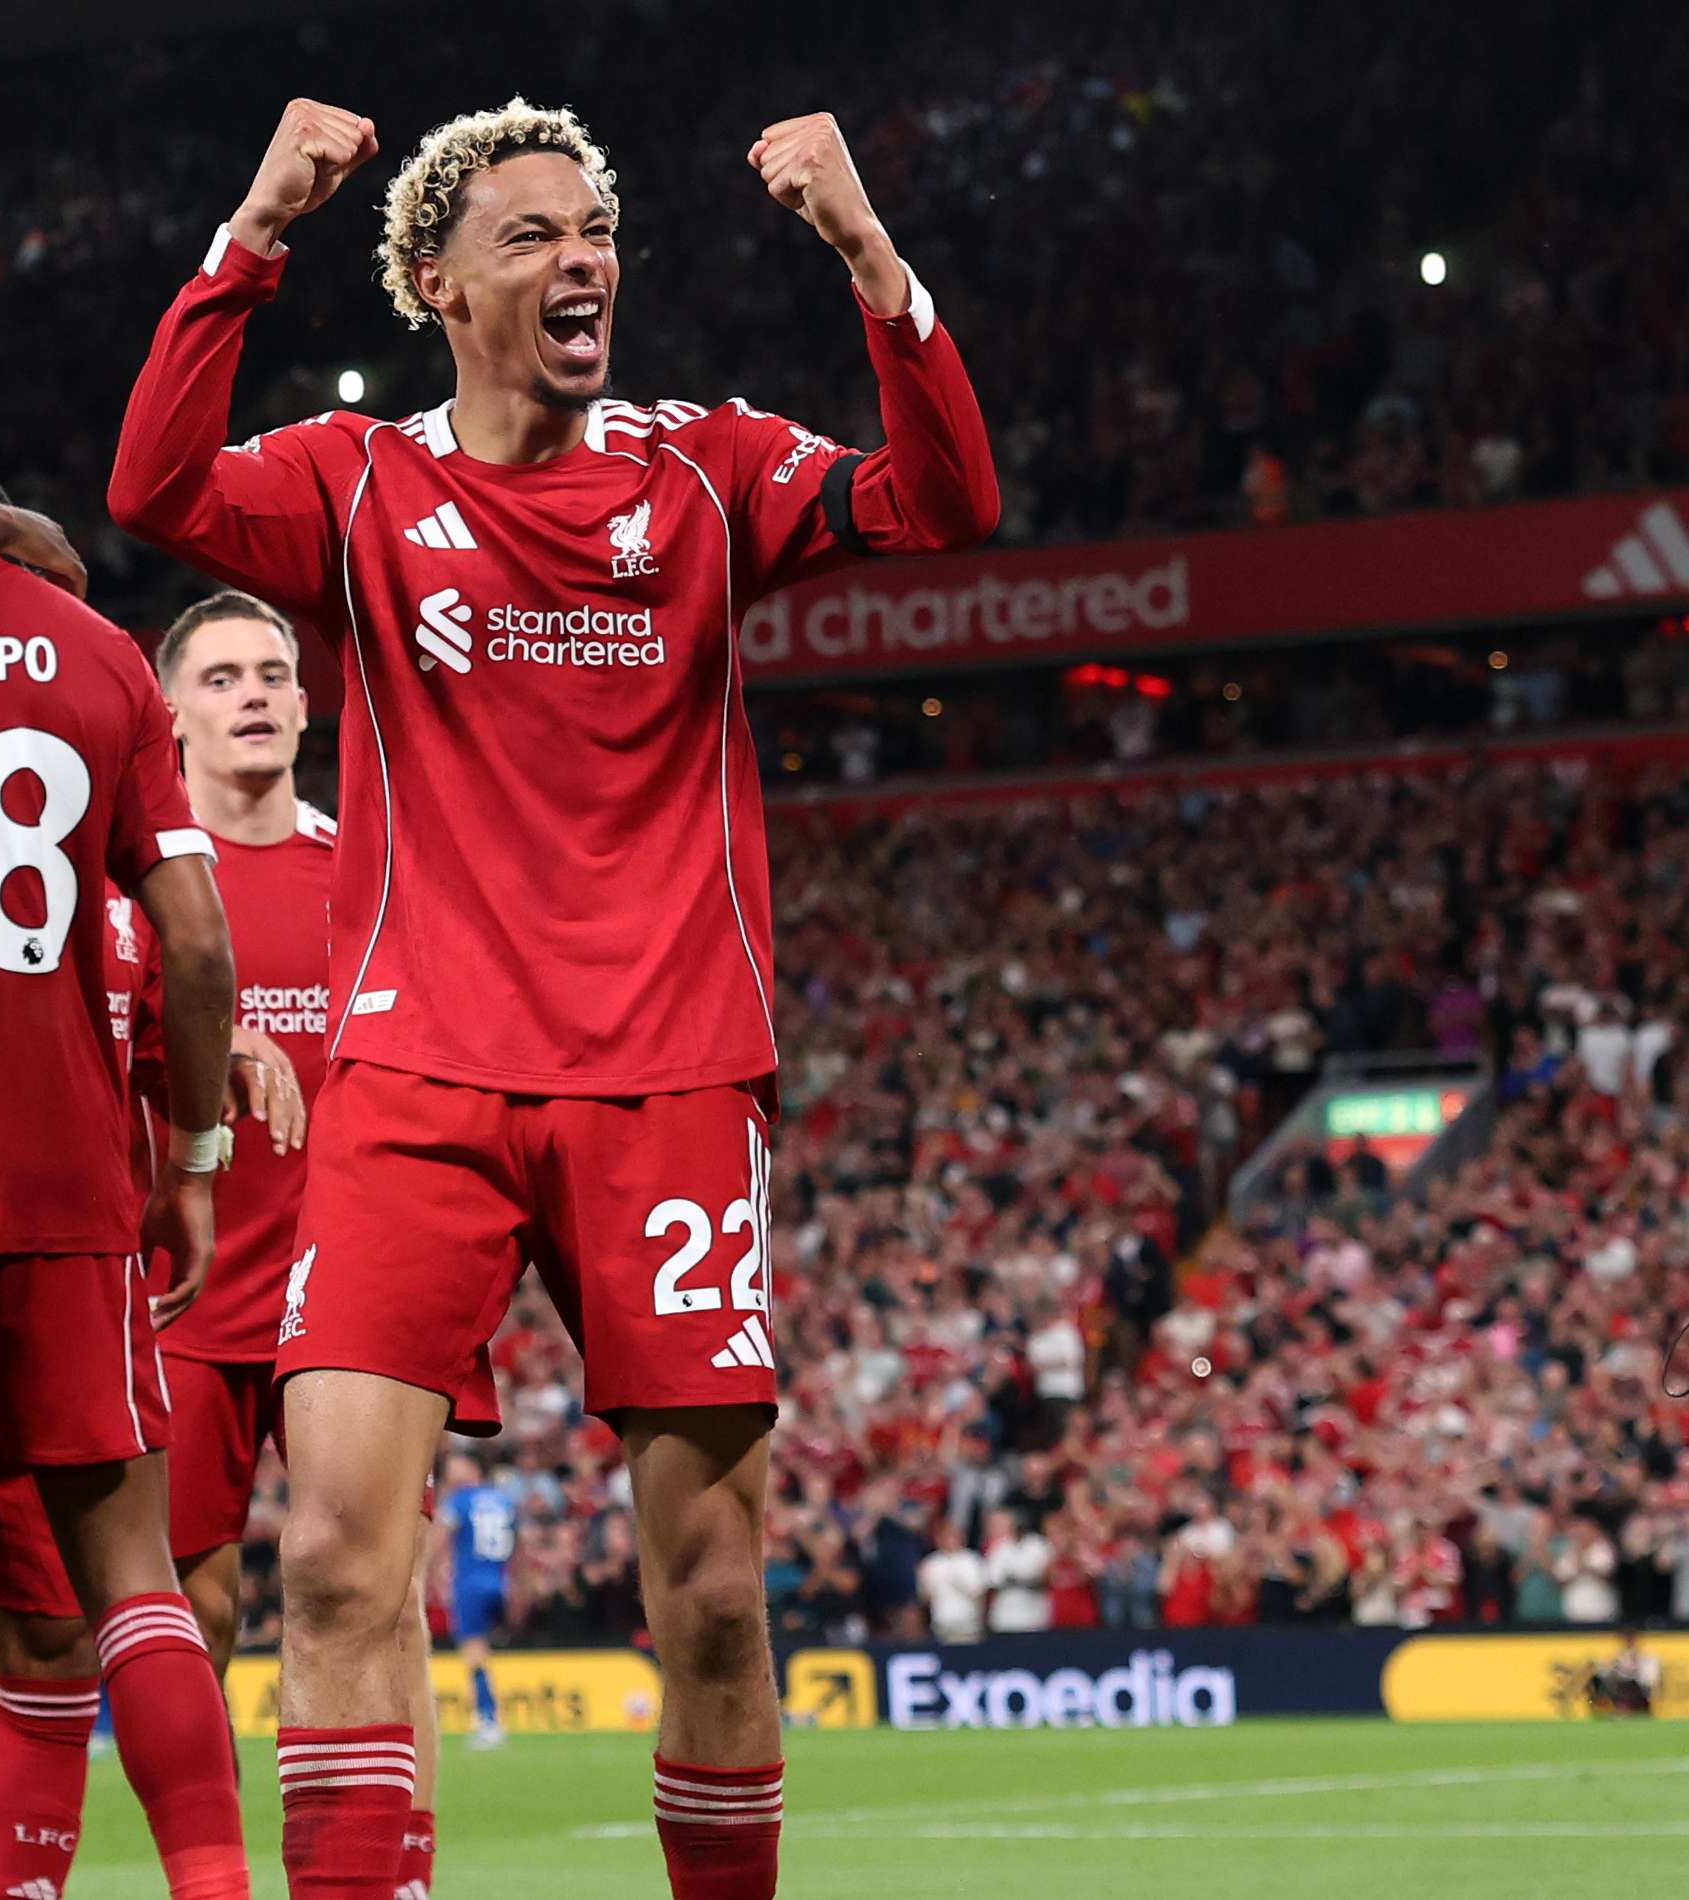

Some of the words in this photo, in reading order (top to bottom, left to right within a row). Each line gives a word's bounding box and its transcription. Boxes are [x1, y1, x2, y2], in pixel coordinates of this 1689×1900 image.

[486, 603, 653, 638] standard
[805, 556, 1189, 657] chartered
[487, 632, 666, 667] chartered
[644, 1197, 767, 1316] 22
[887, 1648, 1236, 1731] Expedia
[13, 1822, 76, 1852] LFC
